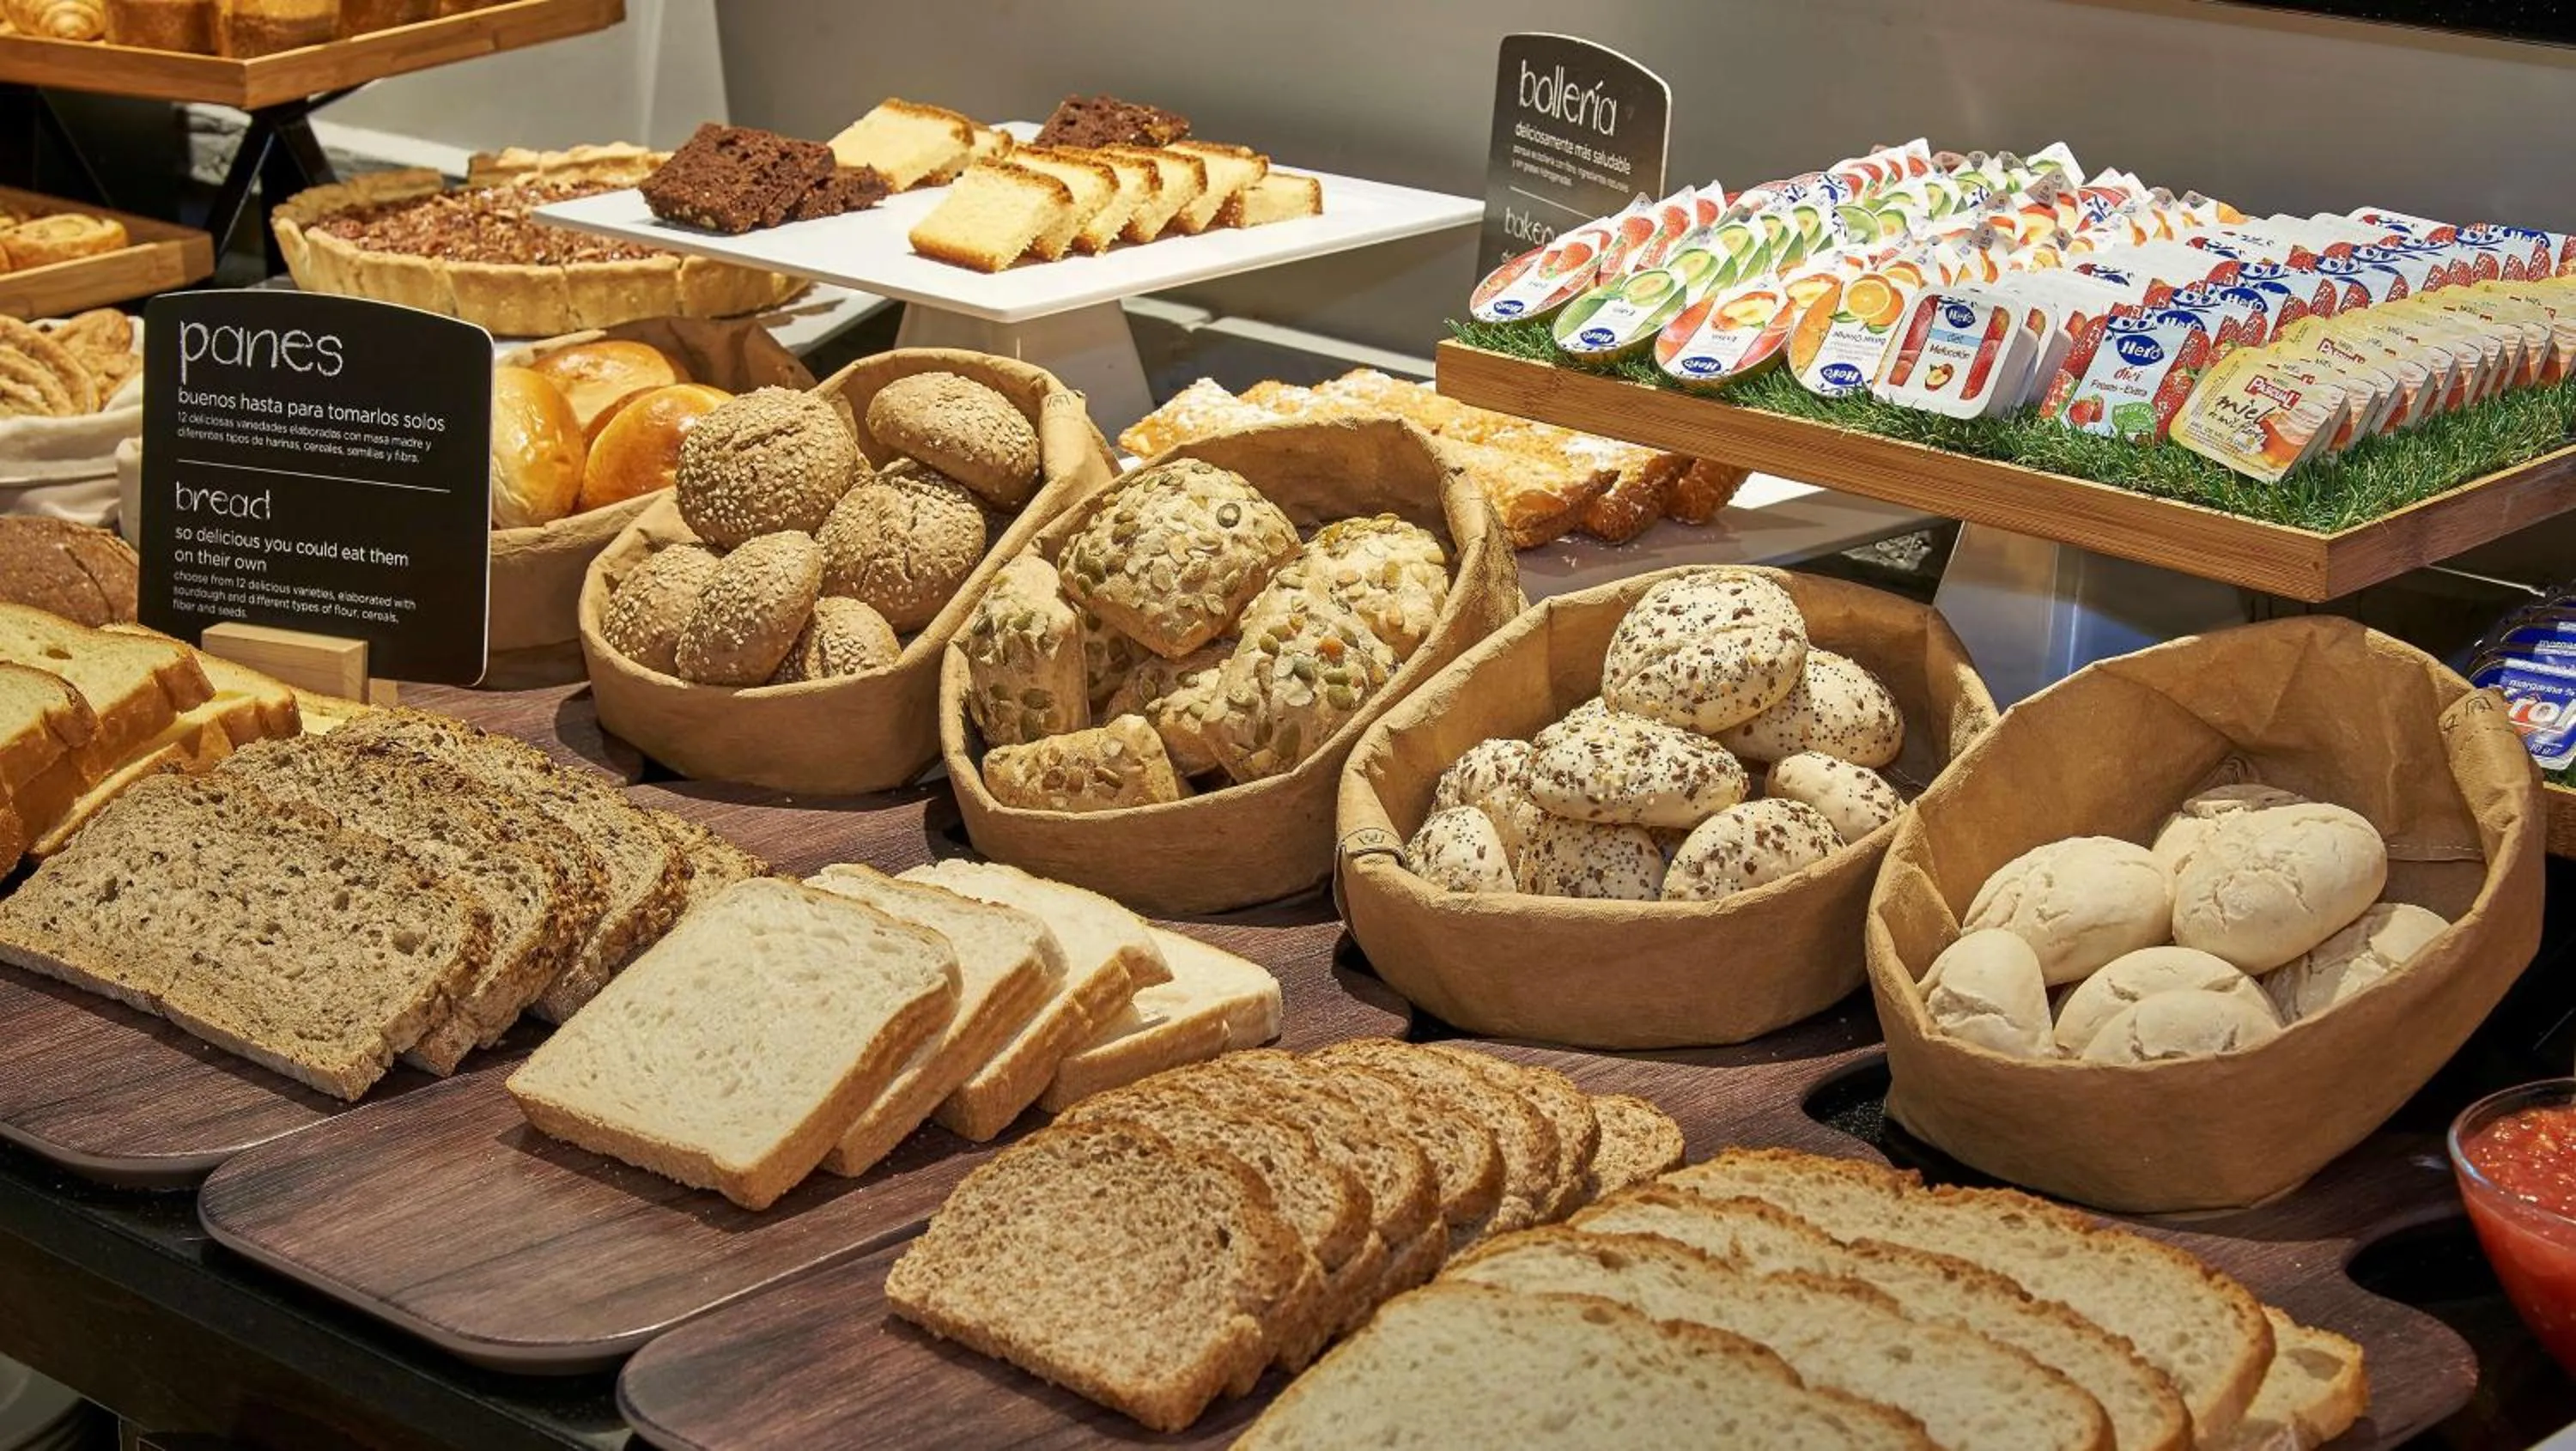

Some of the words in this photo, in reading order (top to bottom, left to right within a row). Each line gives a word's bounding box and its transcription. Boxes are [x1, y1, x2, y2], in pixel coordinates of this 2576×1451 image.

[1519, 59, 1617, 137] bollería
[1593, 150, 1631, 175] saludable
[179, 319, 343, 386] panes
[2121, 340, 2162, 361] Hero
[1823, 367, 1861, 381] Hero
[178, 386, 236, 410] buenos
[240, 392, 283, 413] hasta
[288, 401, 324, 418] para
[328, 404, 399, 427] tomarlos
[404, 412, 446, 432] solos
[2216, 395, 2276, 424] miel
[178, 411, 187, 423] 12
[188, 412, 234, 428] deliciosas
[236, 419, 288, 434] variedades
[289, 425, 342, 440] elaboradas
[343, 431, 361, 442] con
[363, 433, 389, 445] masa
[391, 435, 423, 449] madre
[425, 440, 432, 452] y
[226, 432, 249, 445] tipos
[252, 435, 264, 446] de
[386, 452, 392, 462] y
[176, 480, 270, 519] bread
[174, 549, 193, 563] on
[197, 549, 231, 568] their
[234, 556, 267, 573] own
[175, 526, 192, 540] so
[197, 527, 260, 549] delicious
[264, 537, 292, 553] you
[296, 540, 337, 559] could
[341, 547, 365, 562] eat
[370, 547, 409, 567] them
[173, 570, 208, 584] choose
[211, 574, 234, 587] from
[236, 576, 246, 589] 12
[248, 580, 290, 595] delicious
[338, 591, 392, 608] elaborated
[394, 598, 416, 610] with
[173, 586, 225, 602] sourdough
[228, 592, 246, 604] and
[248, 593, 289, 610] different
[292, 599, 319, 613] types
[321, 603, 332, 615] of
[197, 602, 216, 614] and
